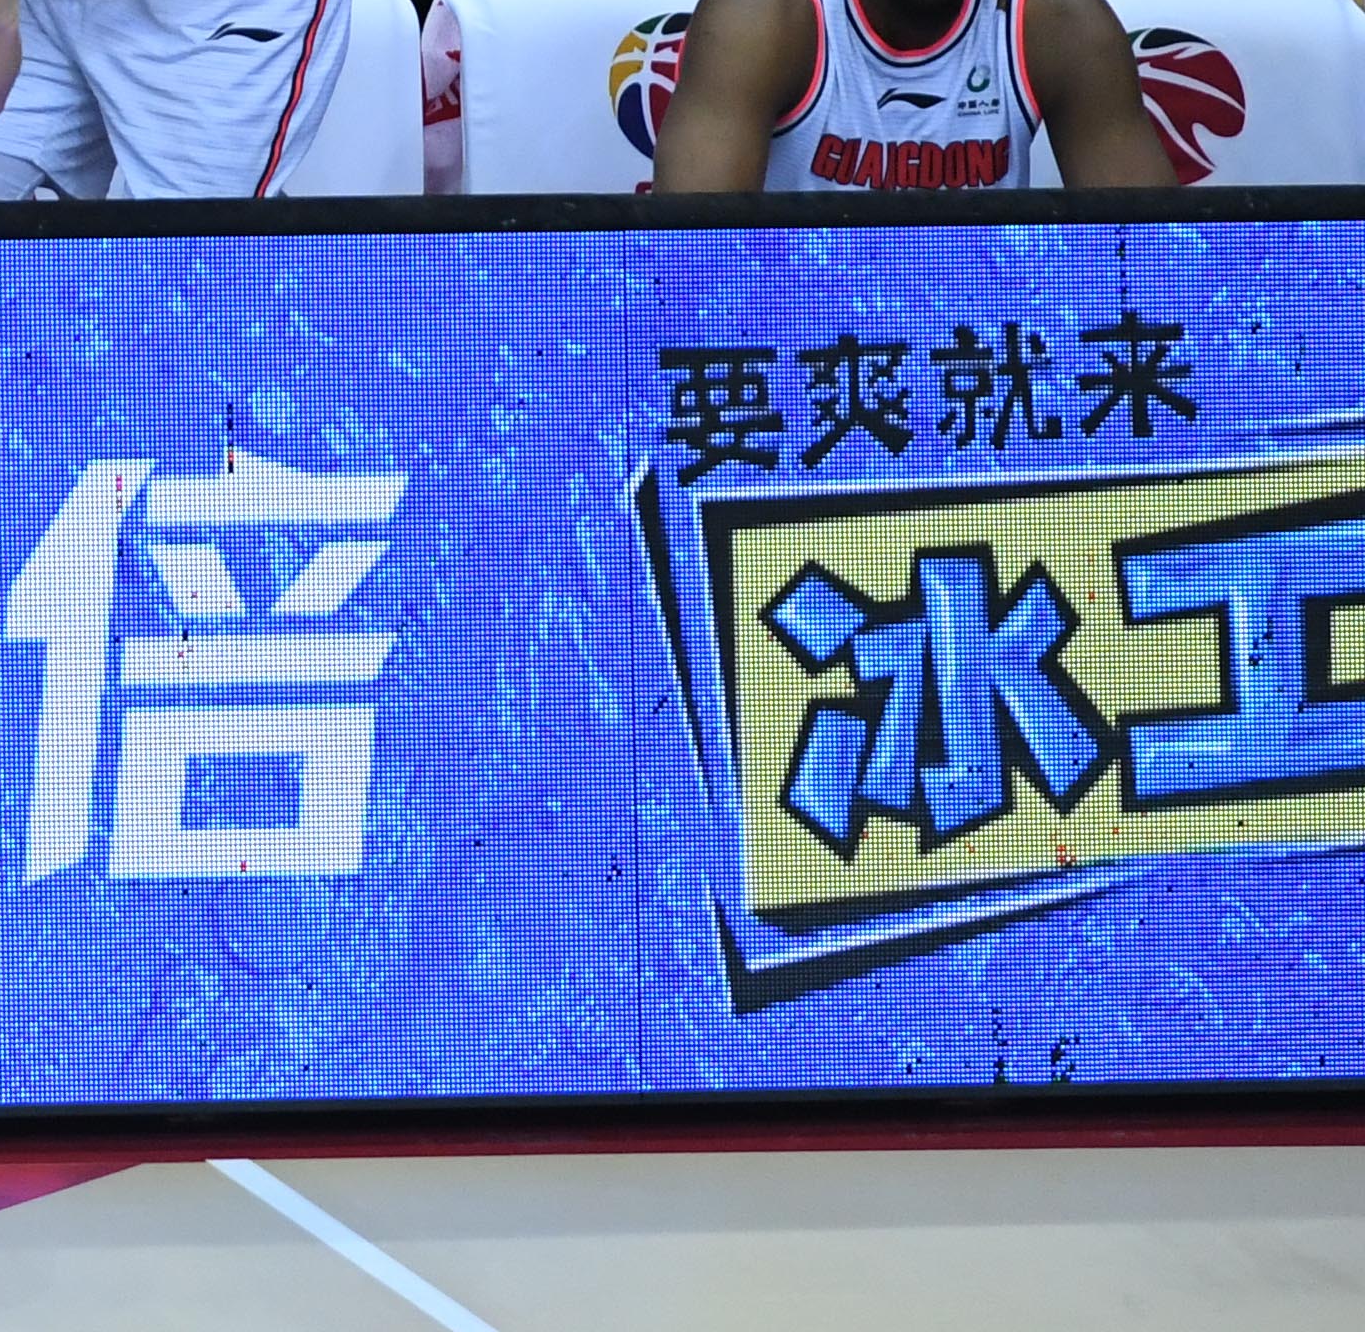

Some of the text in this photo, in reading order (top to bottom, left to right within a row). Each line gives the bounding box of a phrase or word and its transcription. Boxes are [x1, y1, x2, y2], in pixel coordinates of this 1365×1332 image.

[659, 311, 1199, 486] 要爽就来
[758, 498, 1365, 865] 冰工
